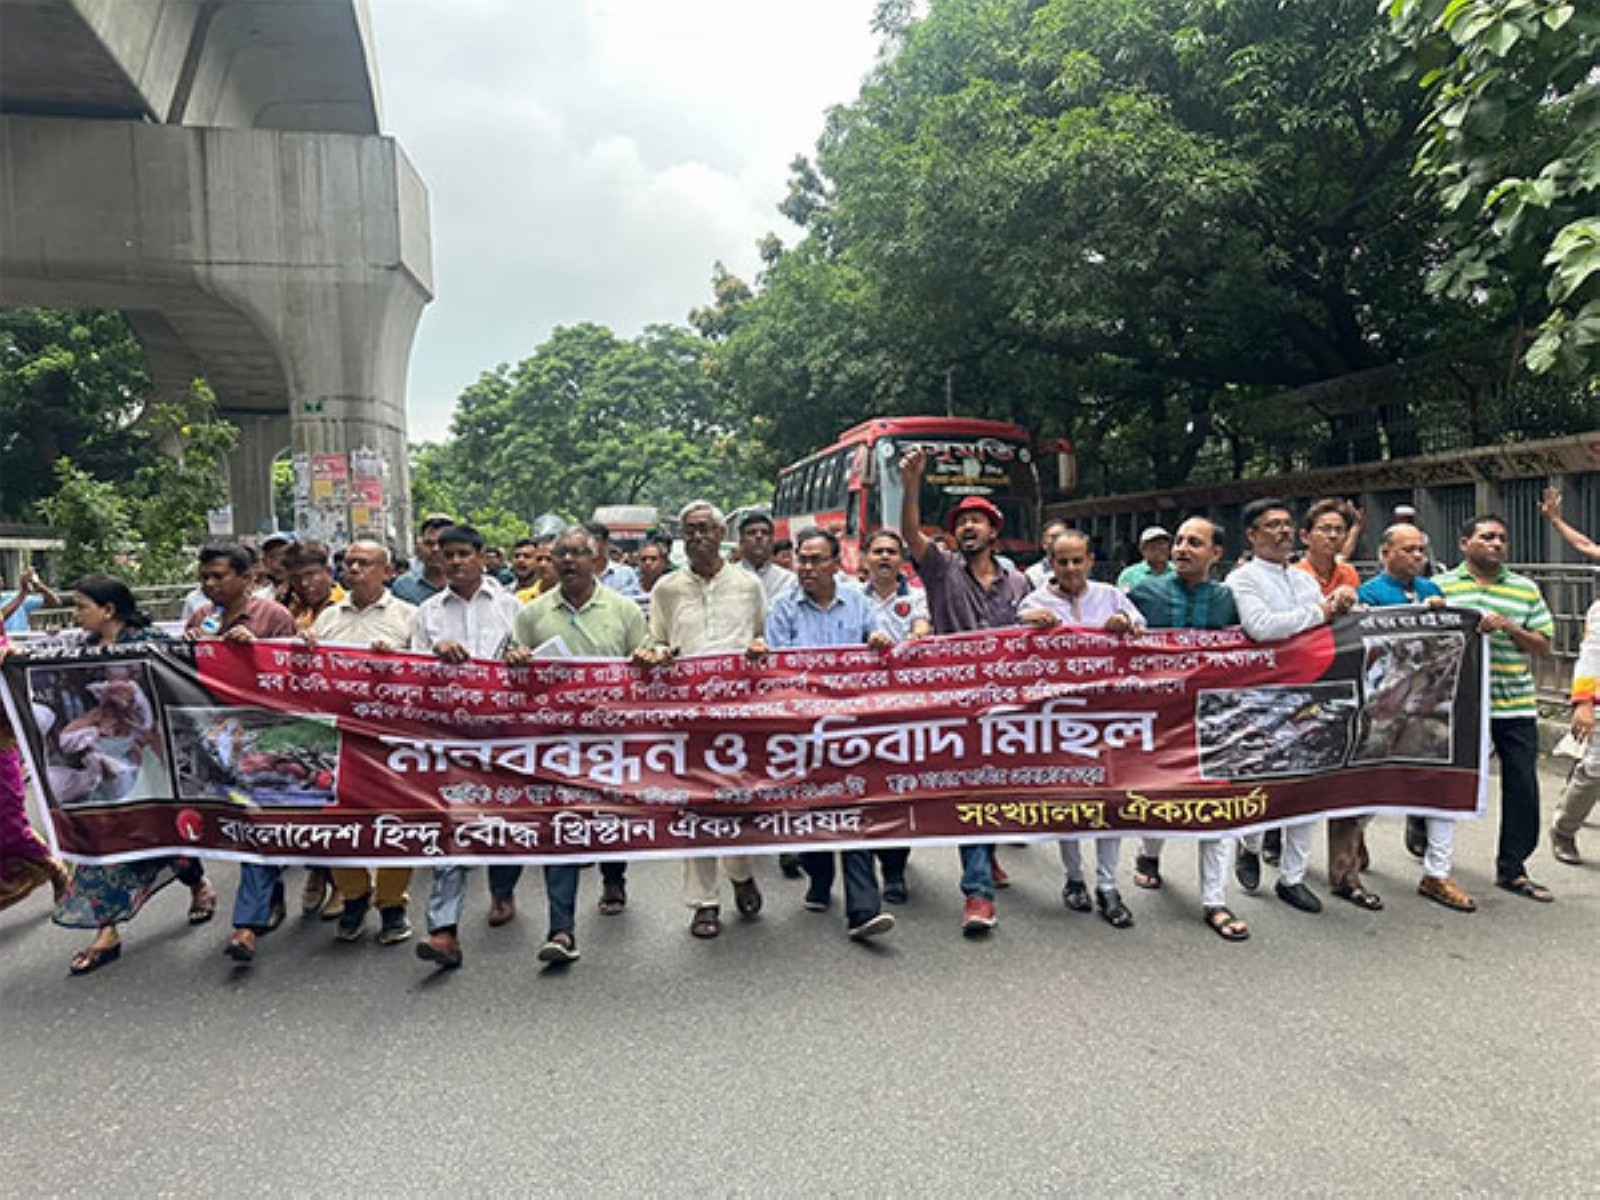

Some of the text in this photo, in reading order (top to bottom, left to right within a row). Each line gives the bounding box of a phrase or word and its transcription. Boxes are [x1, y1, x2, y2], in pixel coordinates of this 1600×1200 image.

[704, 733, 748, 775] ও
[765, 714, 967, 781] প্রতিবাদ
[978, 697, 1157, 759] মিছিল
[956, 786, 1268, 829] সংখ্যালঘু ঐক্যমোর্চা
[217, 815, 362, 850] বাংলাদেশ
[373, 813, 443, 856] হিন্দু
[453, 812, 540, 848] বৌদ্ধ
[667, 808, 742, 840] ঐক্য
